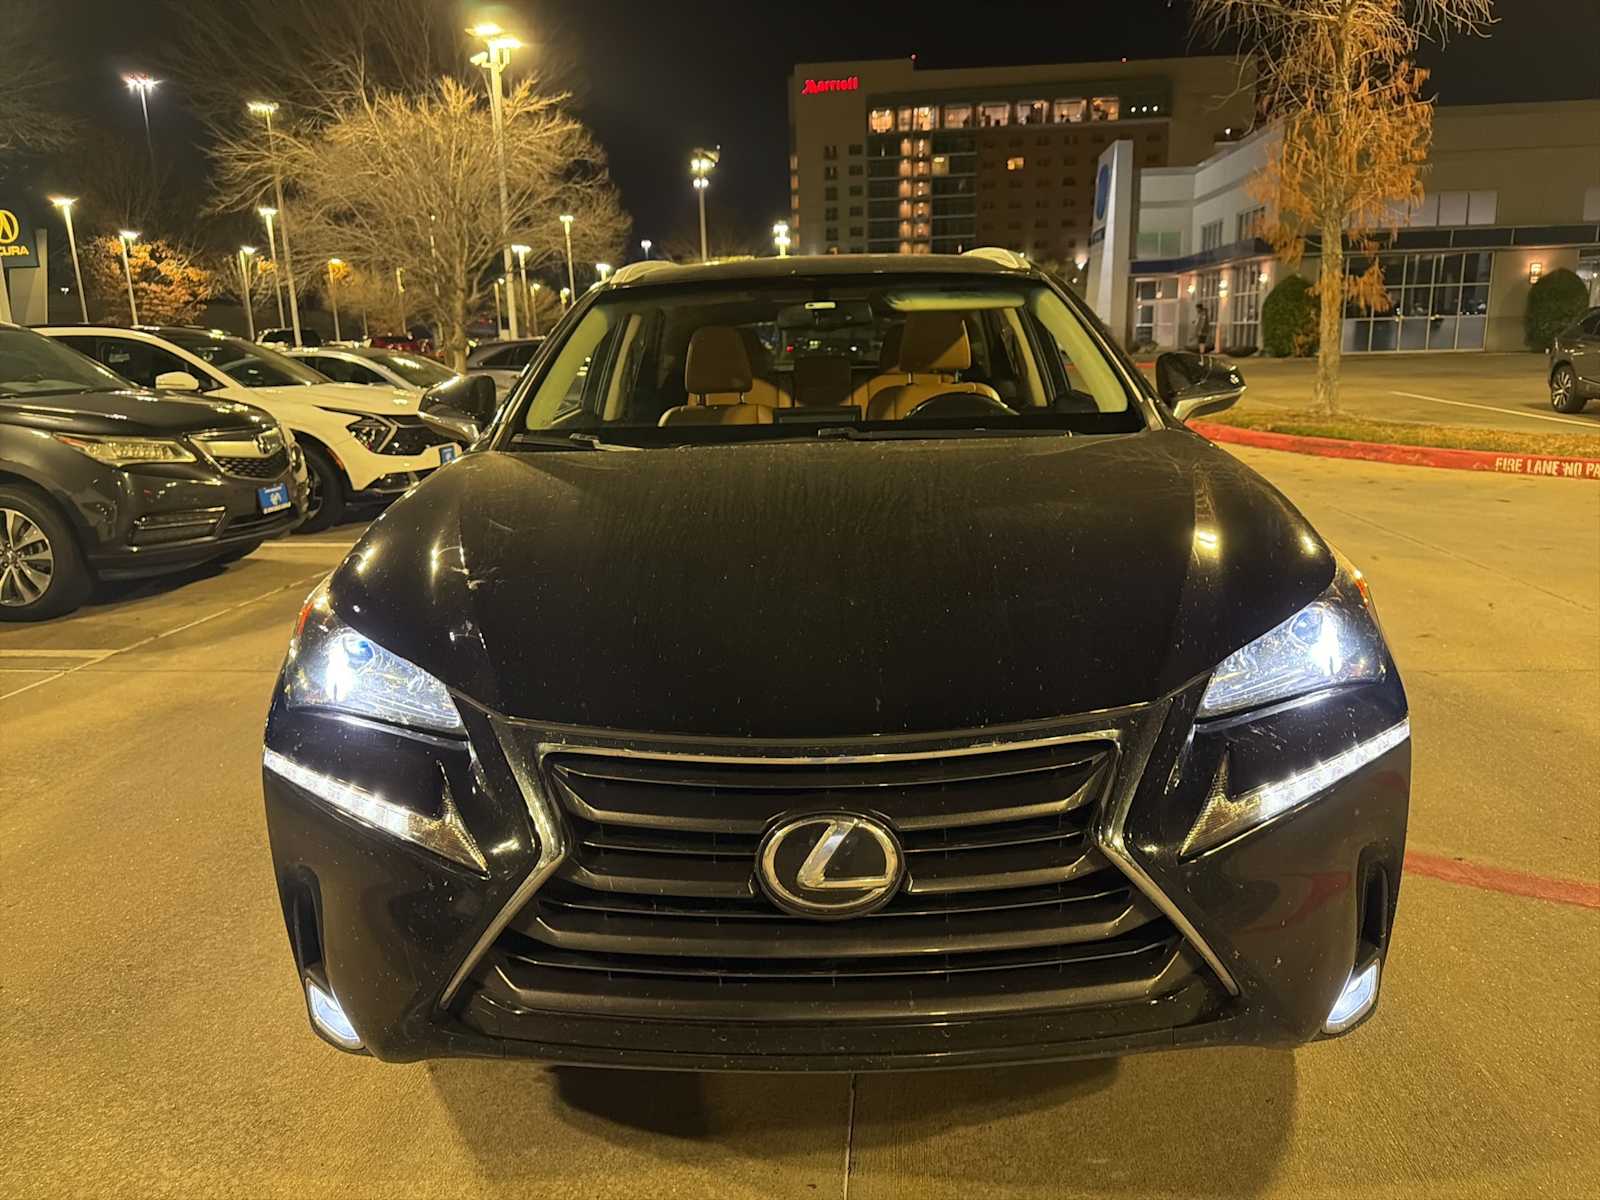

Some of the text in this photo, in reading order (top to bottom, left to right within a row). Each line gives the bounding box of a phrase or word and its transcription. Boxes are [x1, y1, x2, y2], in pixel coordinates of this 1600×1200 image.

[801, 76, 859, 95] Marriott
[1495, 457, 1523, 472] FIRE
[1527, 459, 1560, 476] LANE
[1563, 462, 1582, 477] NO
